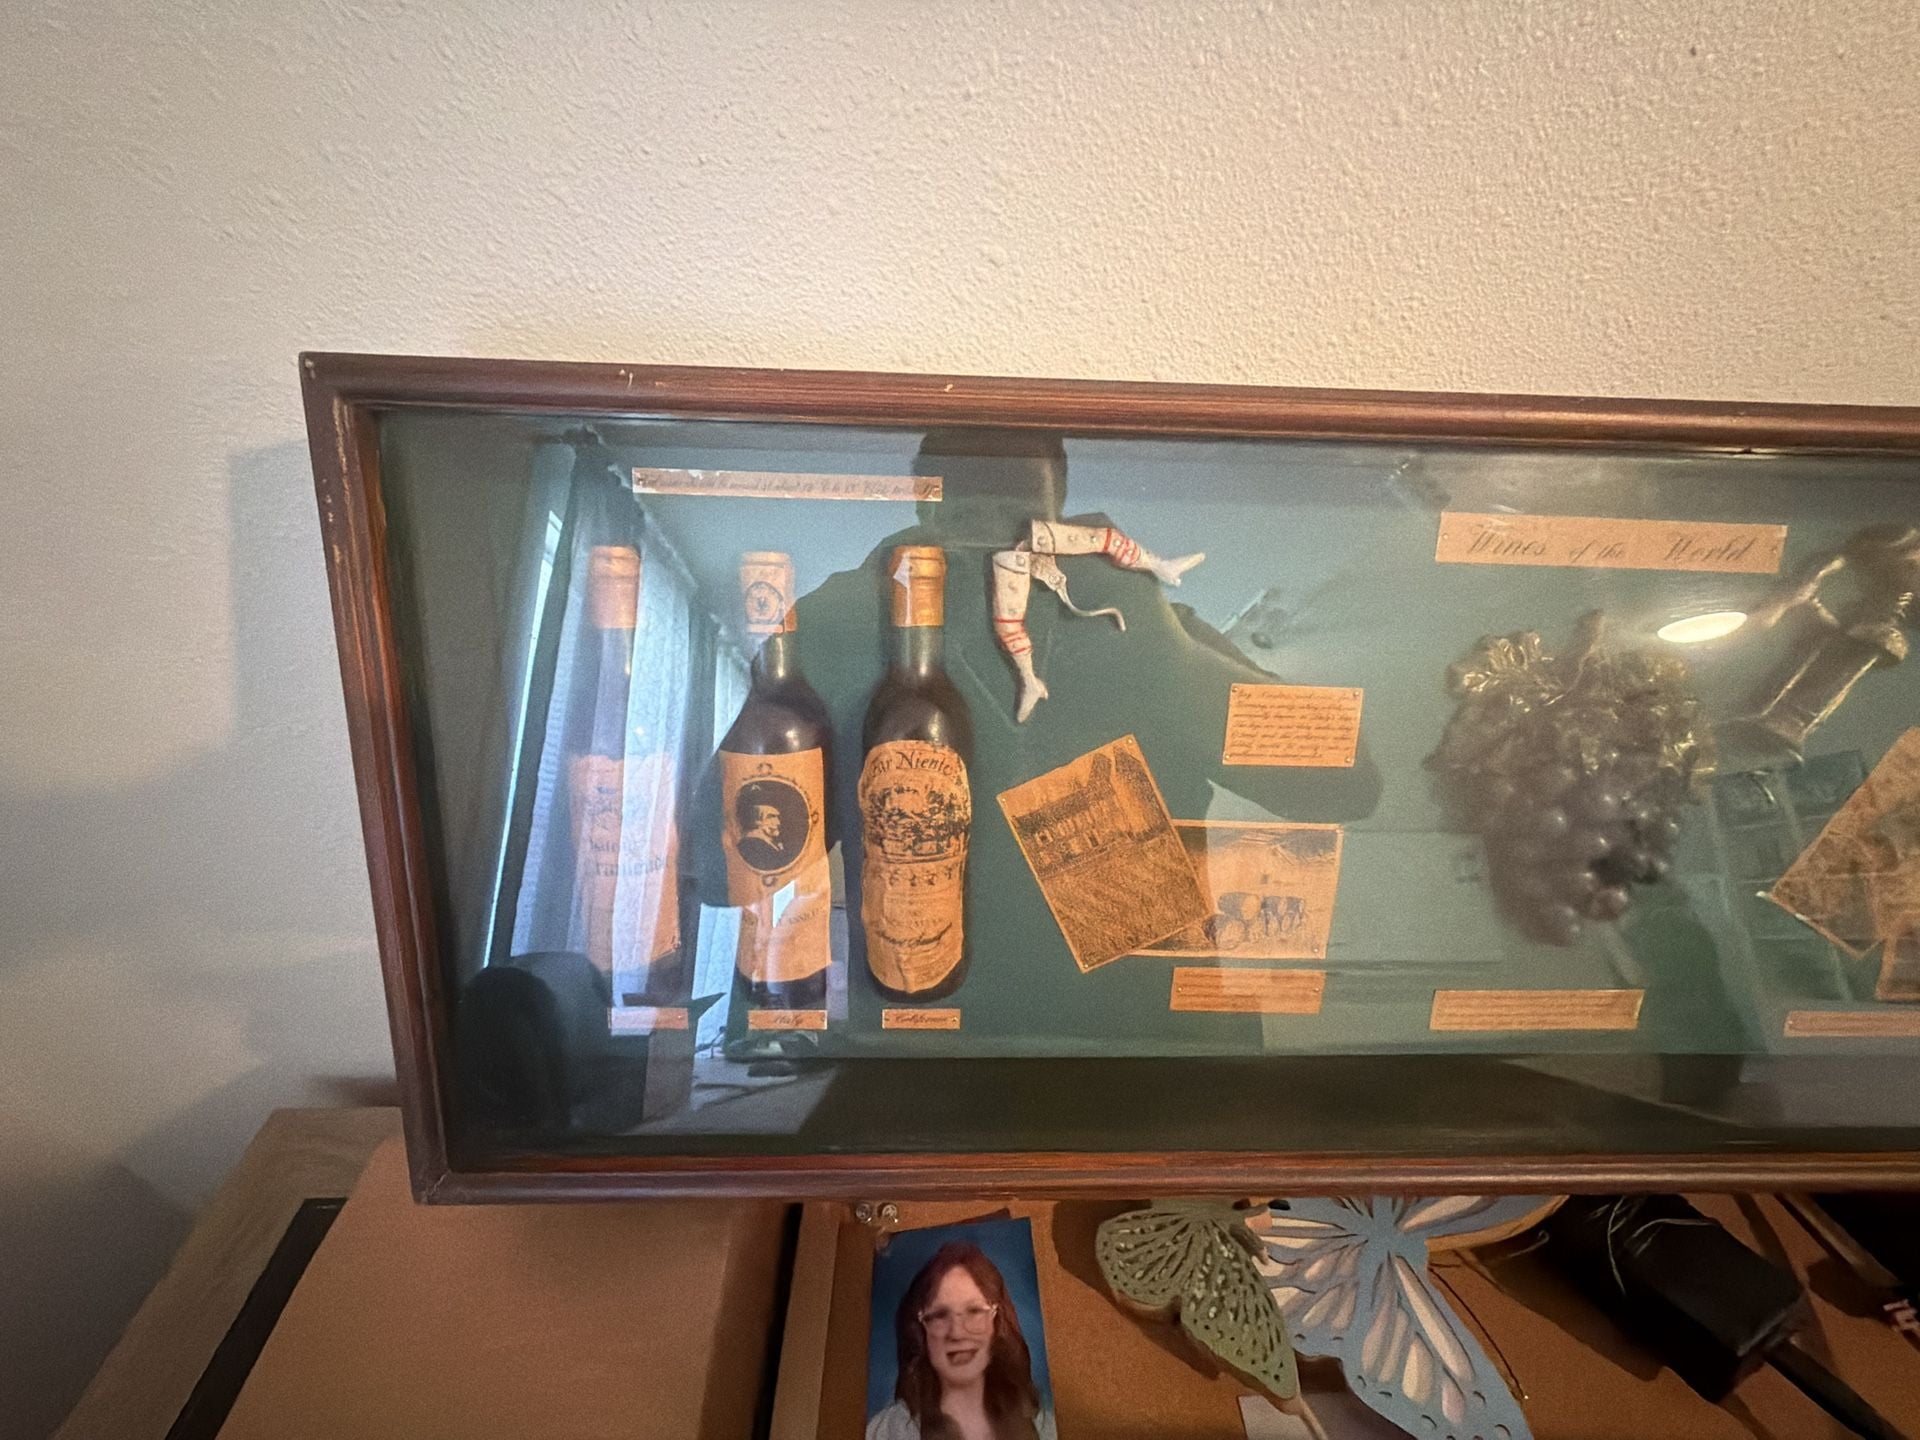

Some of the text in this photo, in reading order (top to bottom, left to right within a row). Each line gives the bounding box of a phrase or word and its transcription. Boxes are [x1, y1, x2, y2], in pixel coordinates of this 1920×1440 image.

[1466, 525, 1758, 563] Wines of the World
[895, 750, 952, 777] Niente
